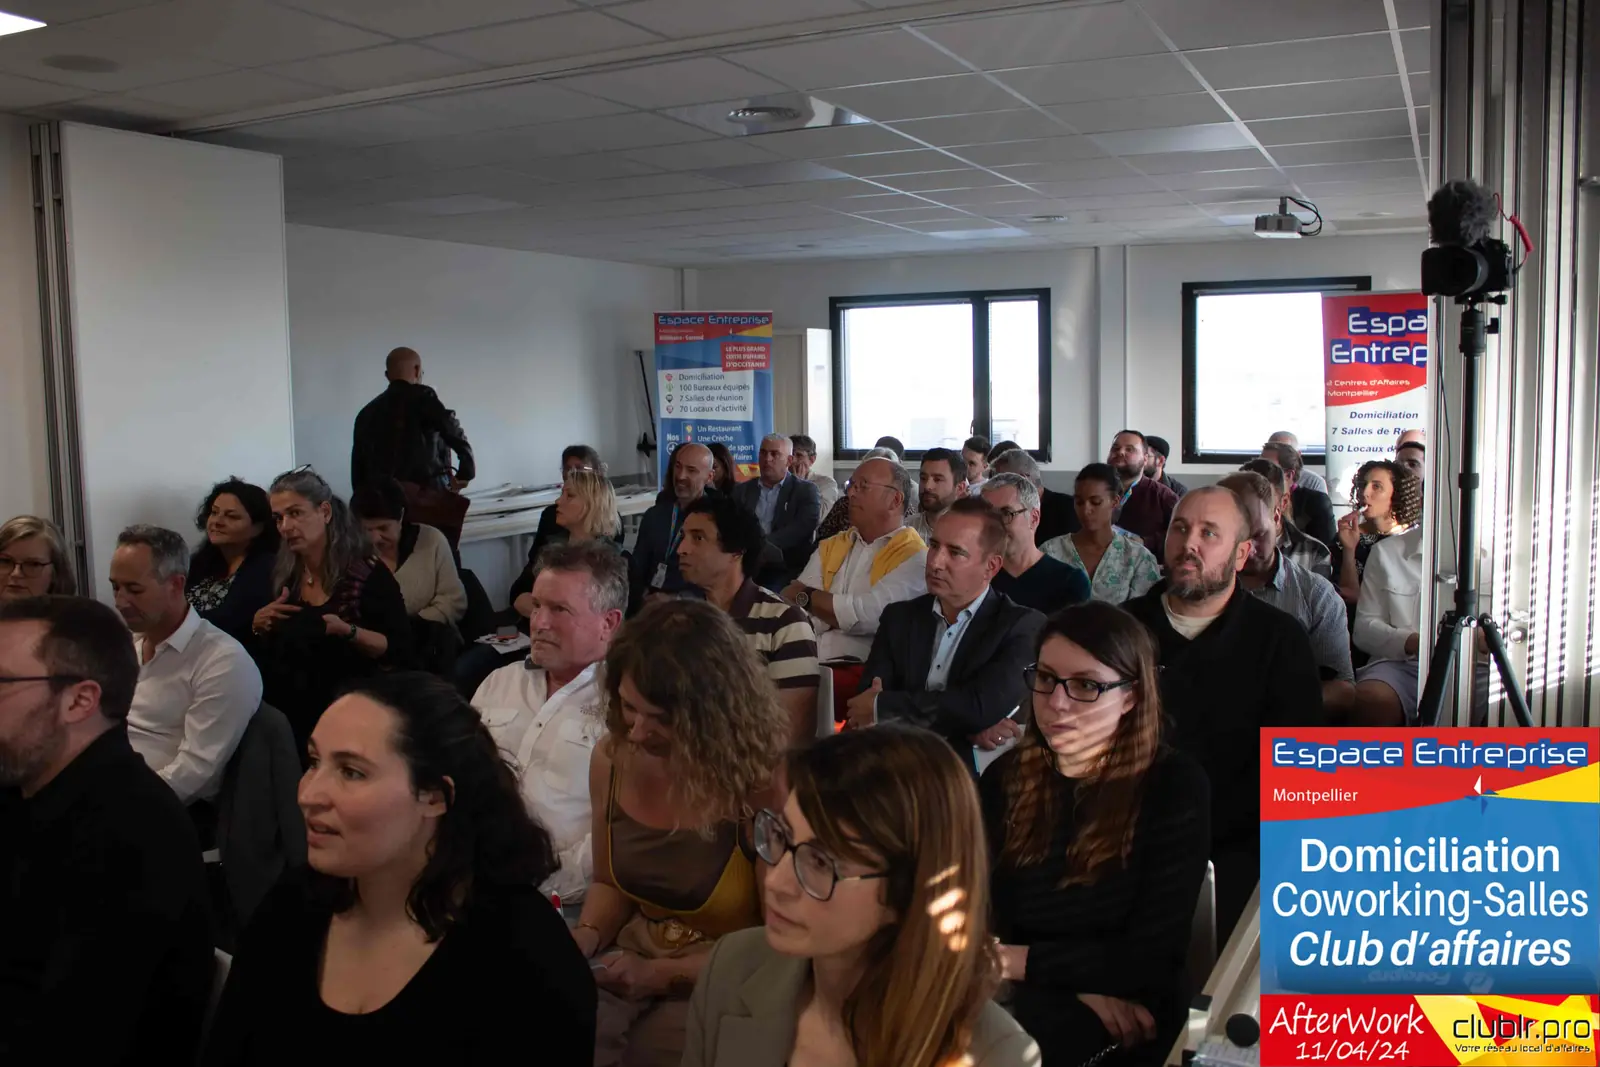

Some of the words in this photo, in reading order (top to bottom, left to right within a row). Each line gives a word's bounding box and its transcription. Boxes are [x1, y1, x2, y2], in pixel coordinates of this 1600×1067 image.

[658, 315, 704, 326] Espace
[708, 315, 769, 325] Entreprise
[725, 345, 732, 353] LE
[732, 345, 746, 353] PLUS
[746, 345, 766, 353] GRAND
[678, 373, 725, 381] Domiciliation
[1334, 379, 1368, 387] Centres
[679, 384, 692, 392] 100
[693, 383, 721, 392] Bureaux
[722, 383, 750, 393] équipés
[1327, 389, 1379, 398] Montpellier
[716, 394, 744, 402] réunion
[714, 404, 748, 412] d'activité
[1349, 411, 1419, 419] Domiciliation
[1331, 427, 1338, 435] 7
[1341, 427, 1373, 435] Salles
[1376, 427, 1390, 435] de
[666, 433, 680, 441] Nos
[711, 434, 734, 442] Crèche
[738, 444, 754, 452] sport
[1331, 445, 1344, 453] 30
[1347, 444, 1384, 453] Locaux
